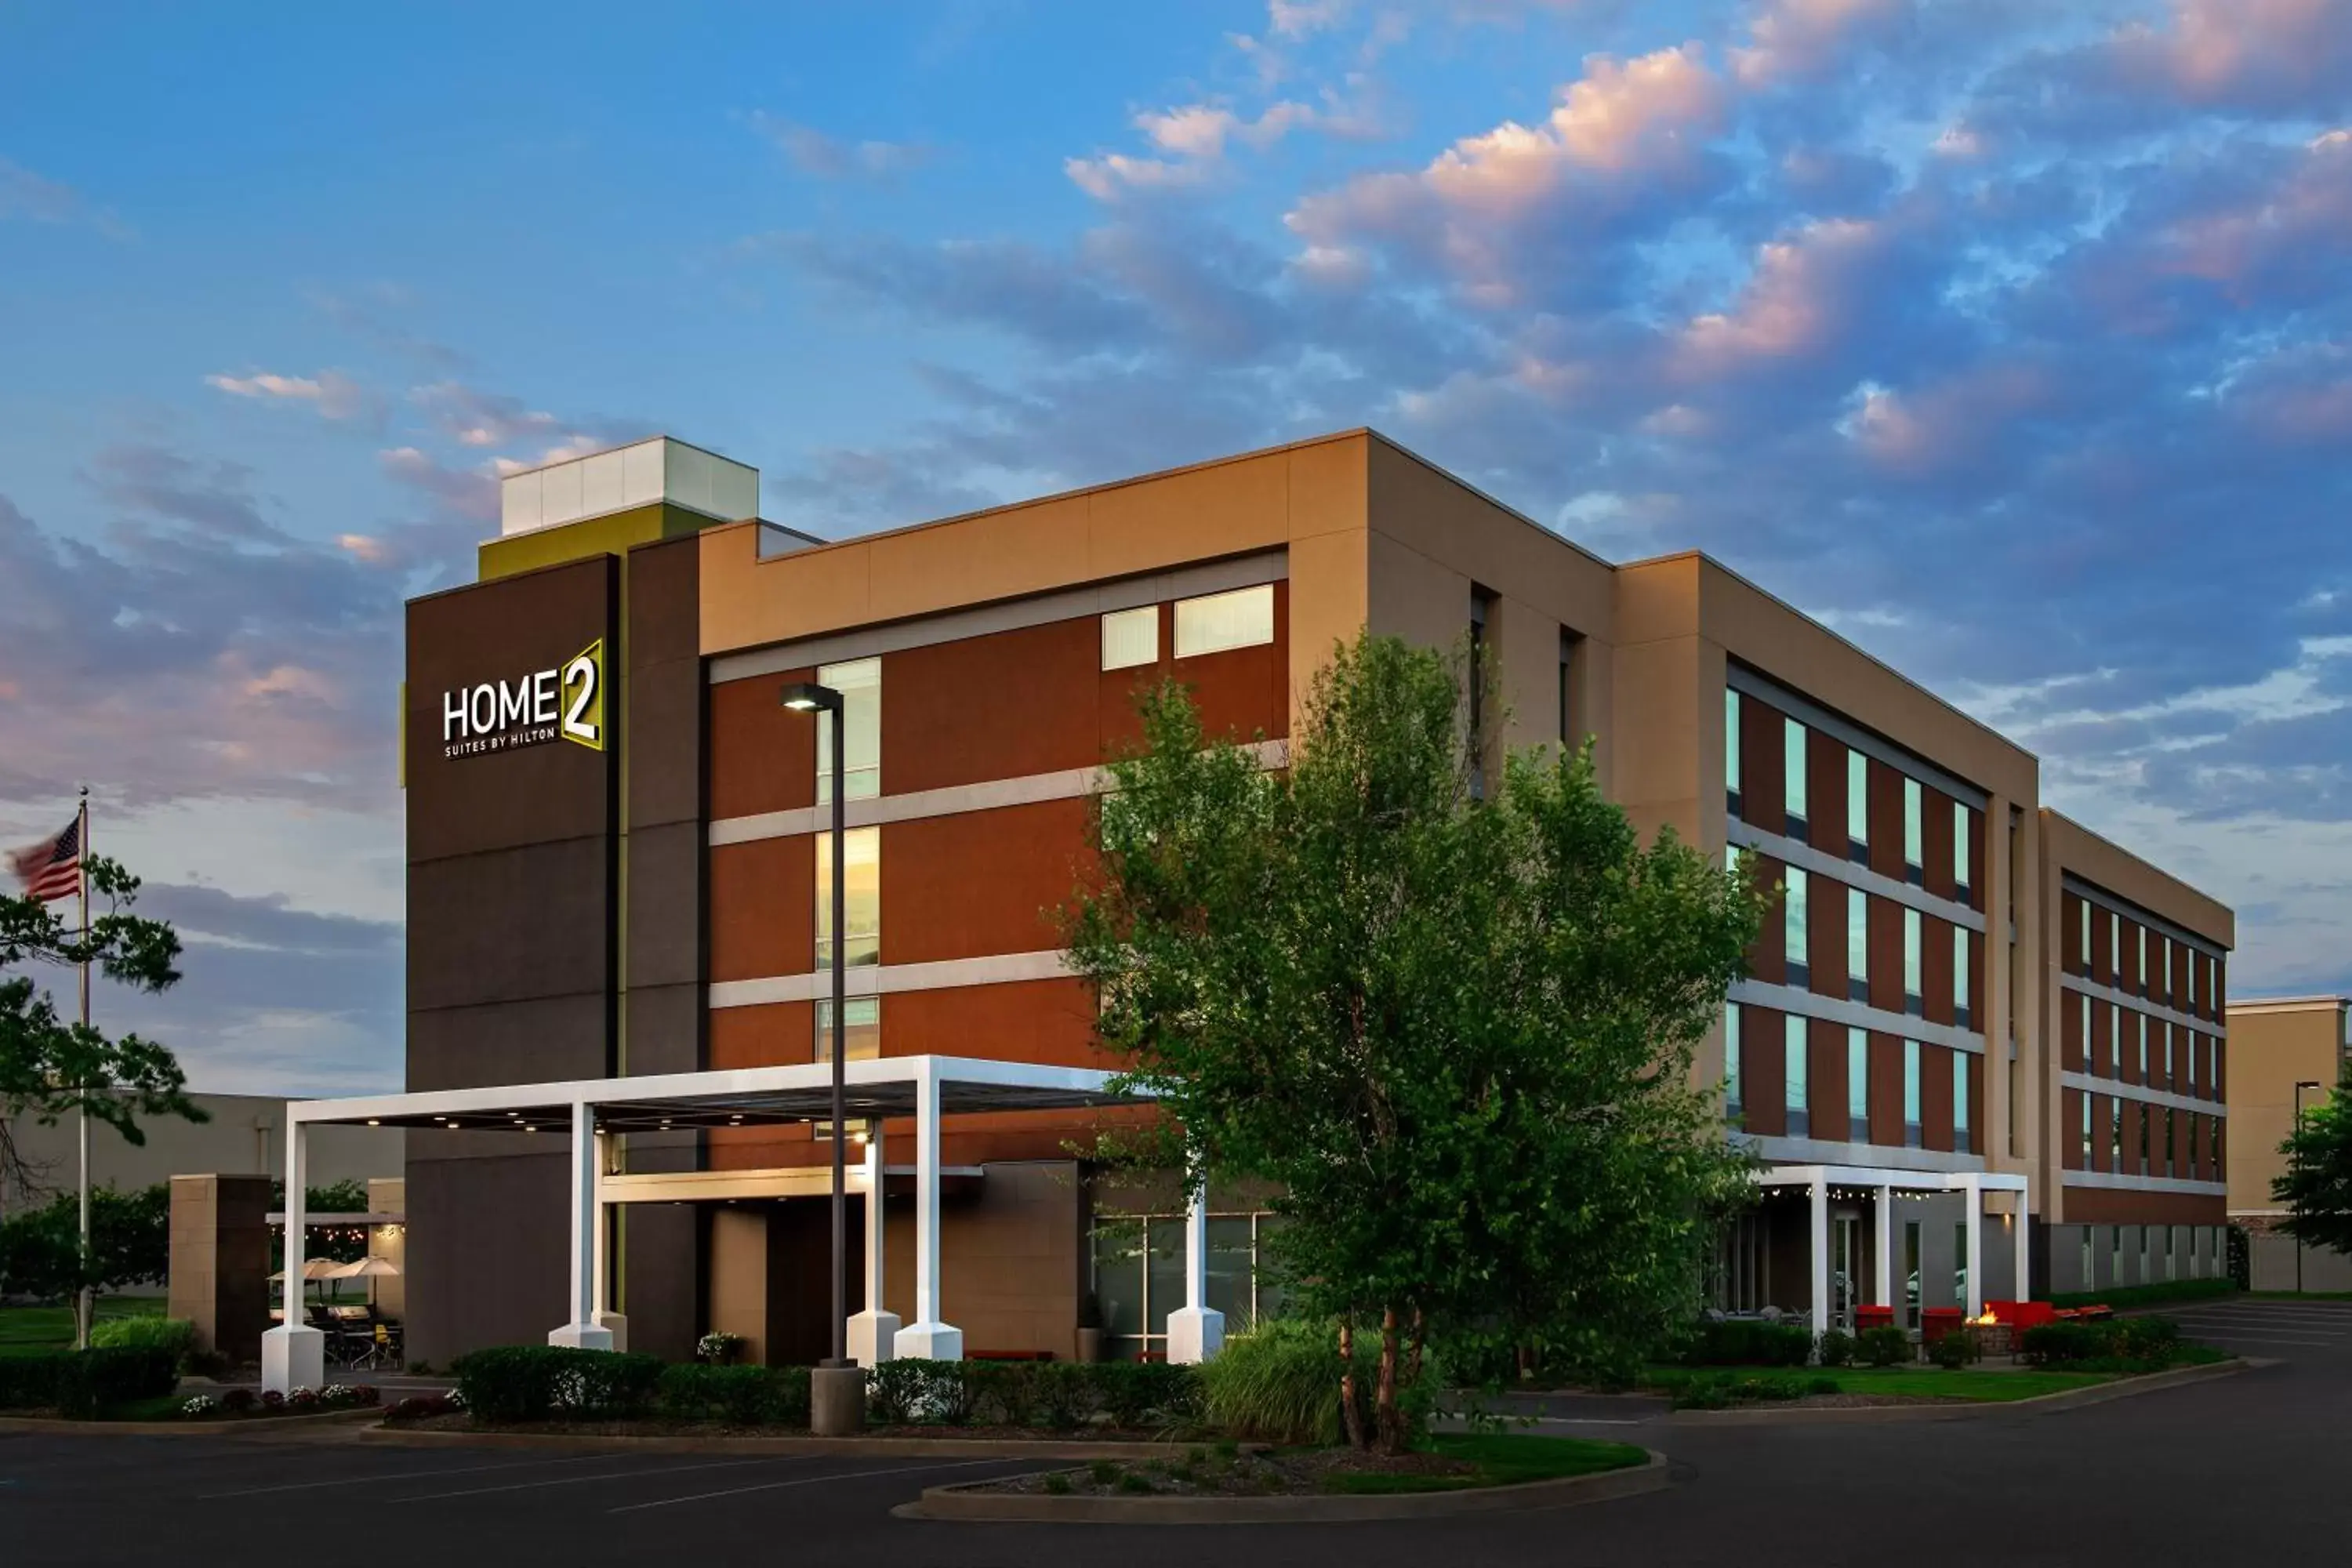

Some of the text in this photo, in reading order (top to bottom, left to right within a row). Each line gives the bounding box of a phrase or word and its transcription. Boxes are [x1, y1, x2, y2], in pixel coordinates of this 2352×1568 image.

[445, 727, 555, 757] SUITES BY HILTON
